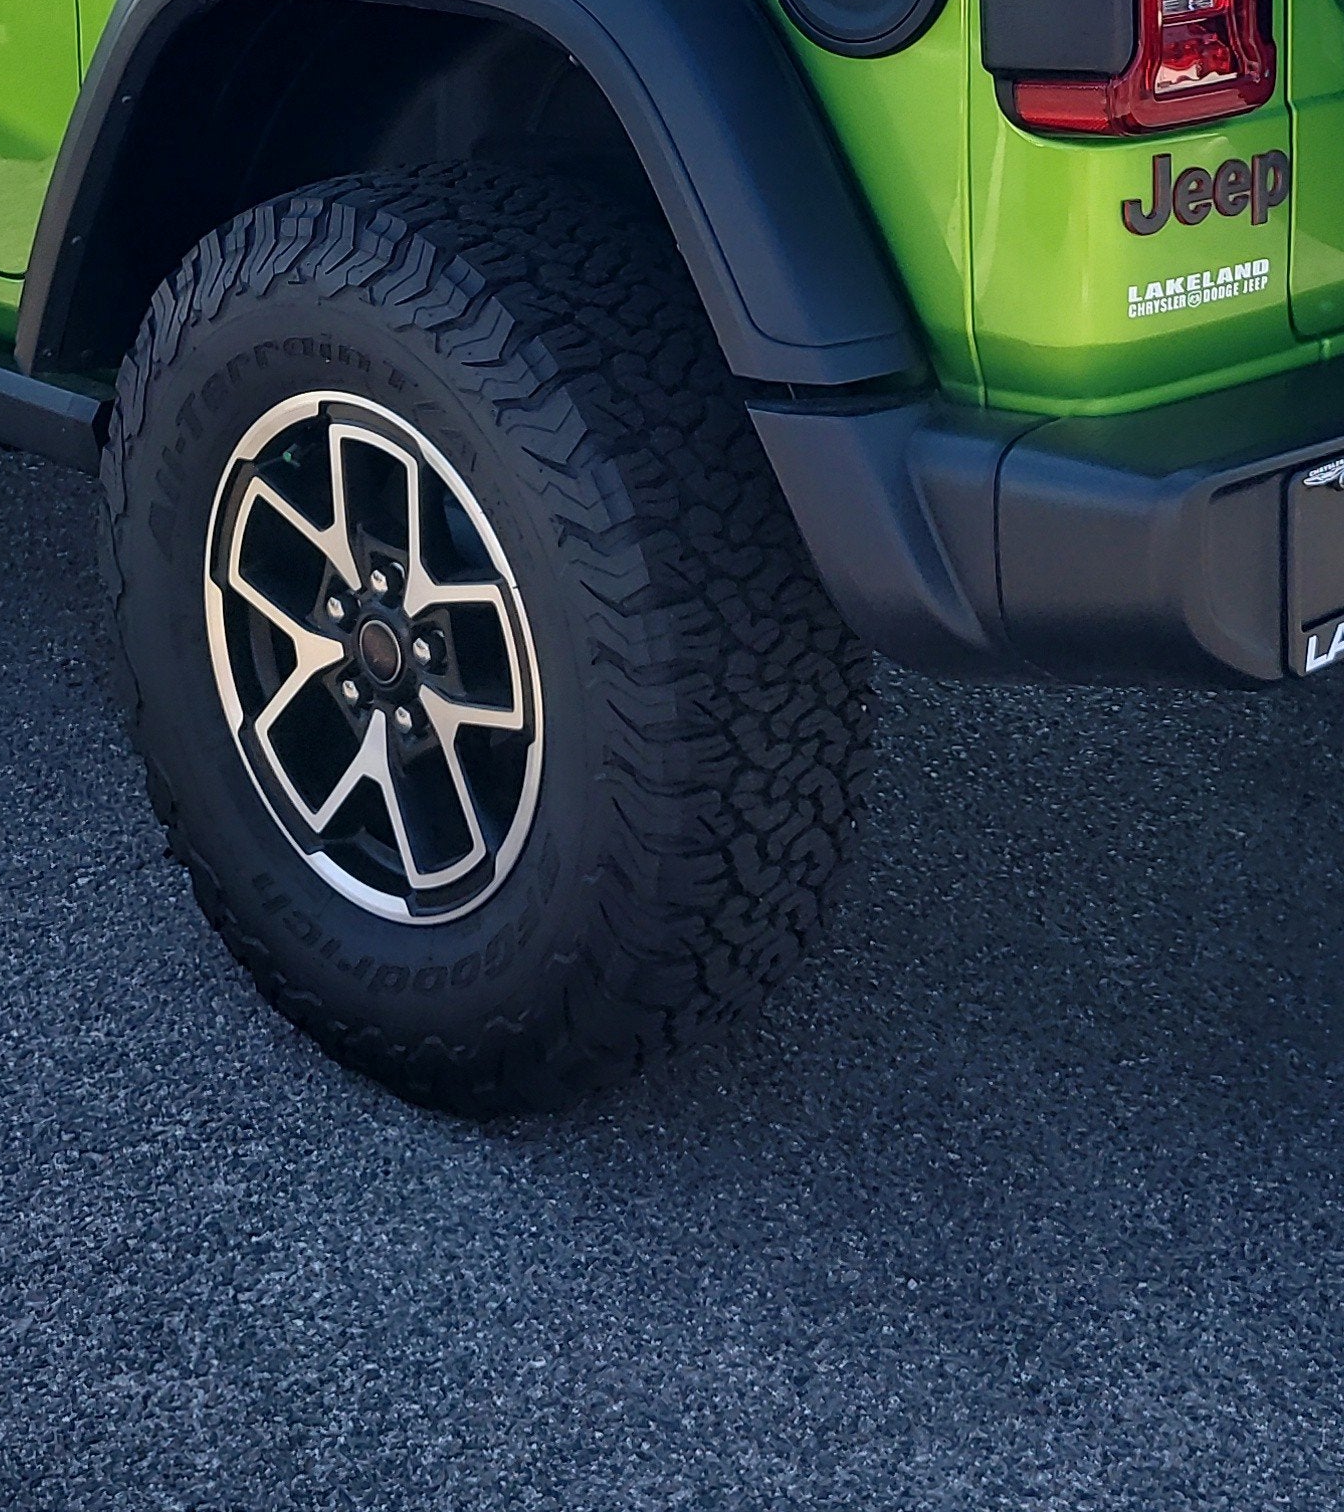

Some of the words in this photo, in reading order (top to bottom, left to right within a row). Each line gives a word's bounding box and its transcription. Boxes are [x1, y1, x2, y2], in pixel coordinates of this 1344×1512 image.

[1122, 149, 1290, 236] Jeep
[1128, 258, 1270, 303] LAKELAND
[1128, 292, 1187, 318] CHRYSLER
[1203, 281, 1239, 303] DODGE
[1242, 275, 1268, 294] JEEP
